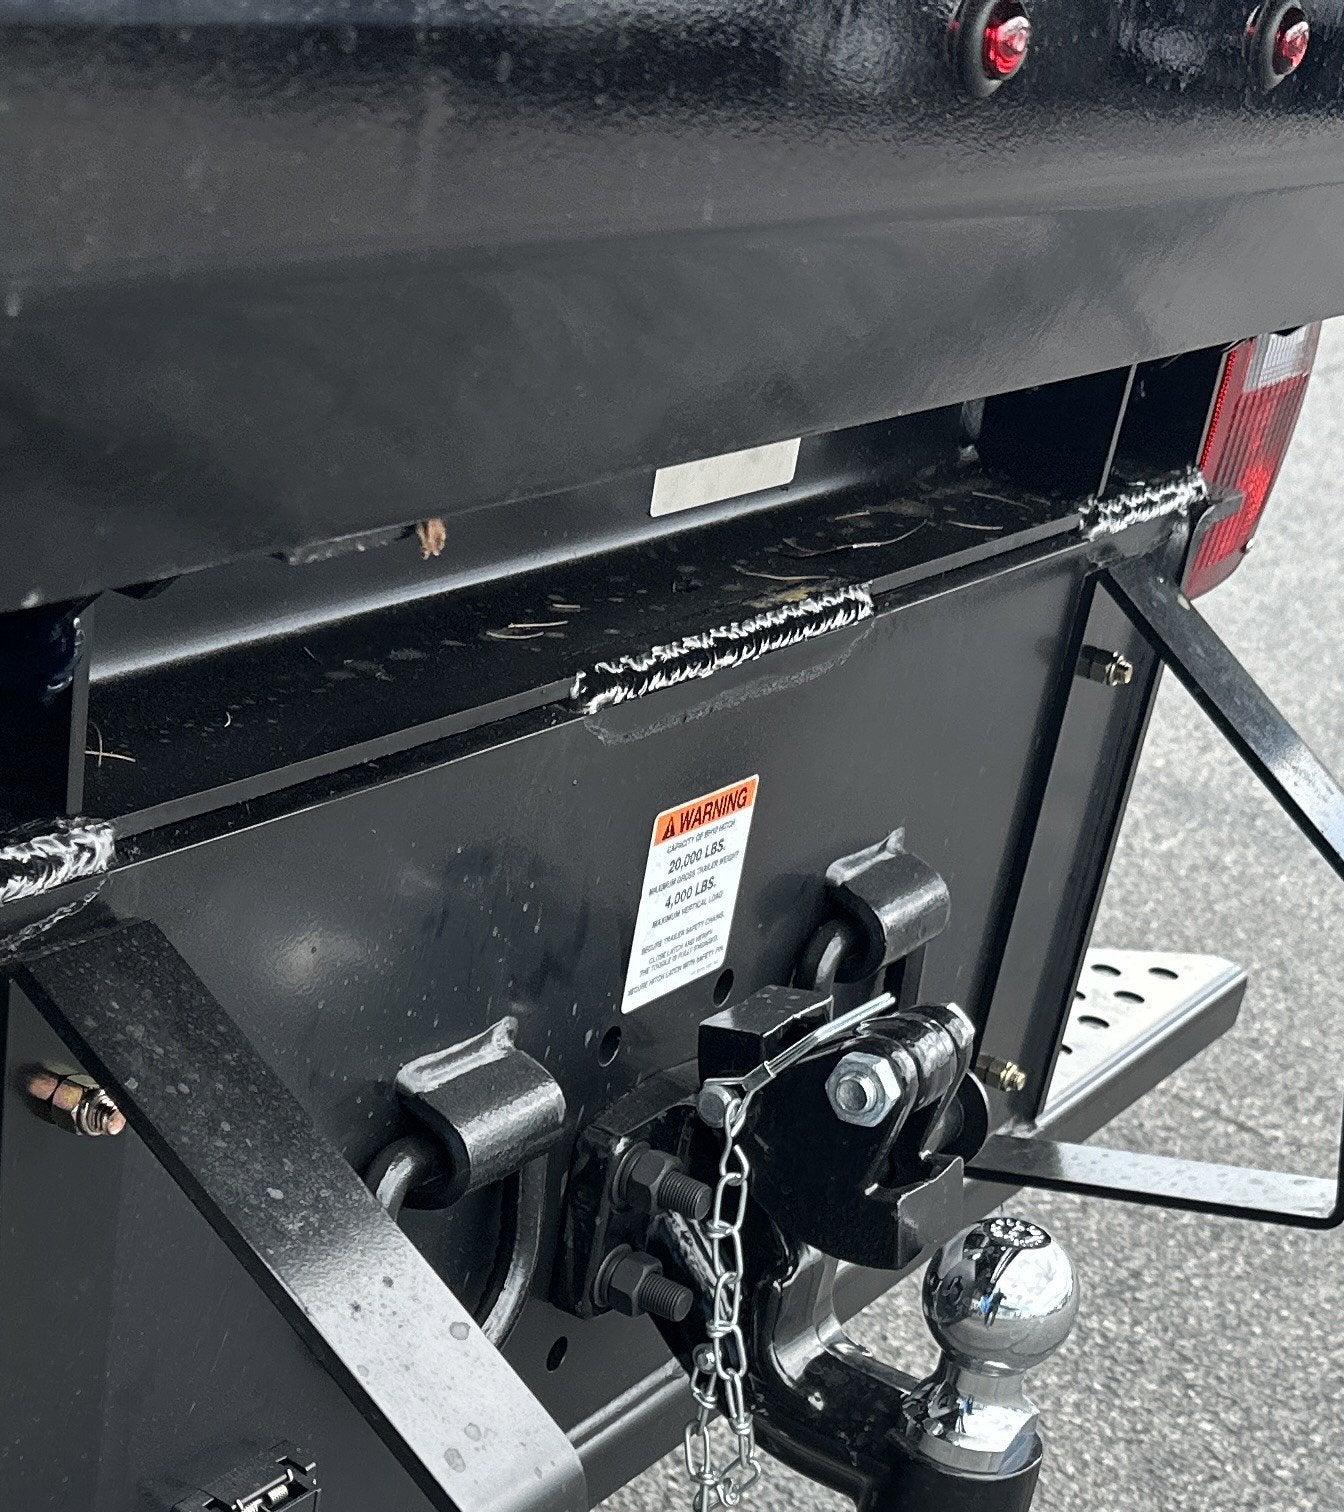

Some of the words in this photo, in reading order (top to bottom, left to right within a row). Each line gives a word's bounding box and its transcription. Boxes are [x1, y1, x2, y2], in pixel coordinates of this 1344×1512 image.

[679, 786, 748, 833] WARNING
[668, 848, 703, 875] 20,000
[704, 838, 726, 859] LBS.
[648, 877, 677, 896] MAXIMUM
[696, 859, 719, 876] TRAILER
[665, 885, 693, 909] 4,000
[694, 876, 717, 897] LBS.
[652, 909, 681, 928] MAXIMUM
